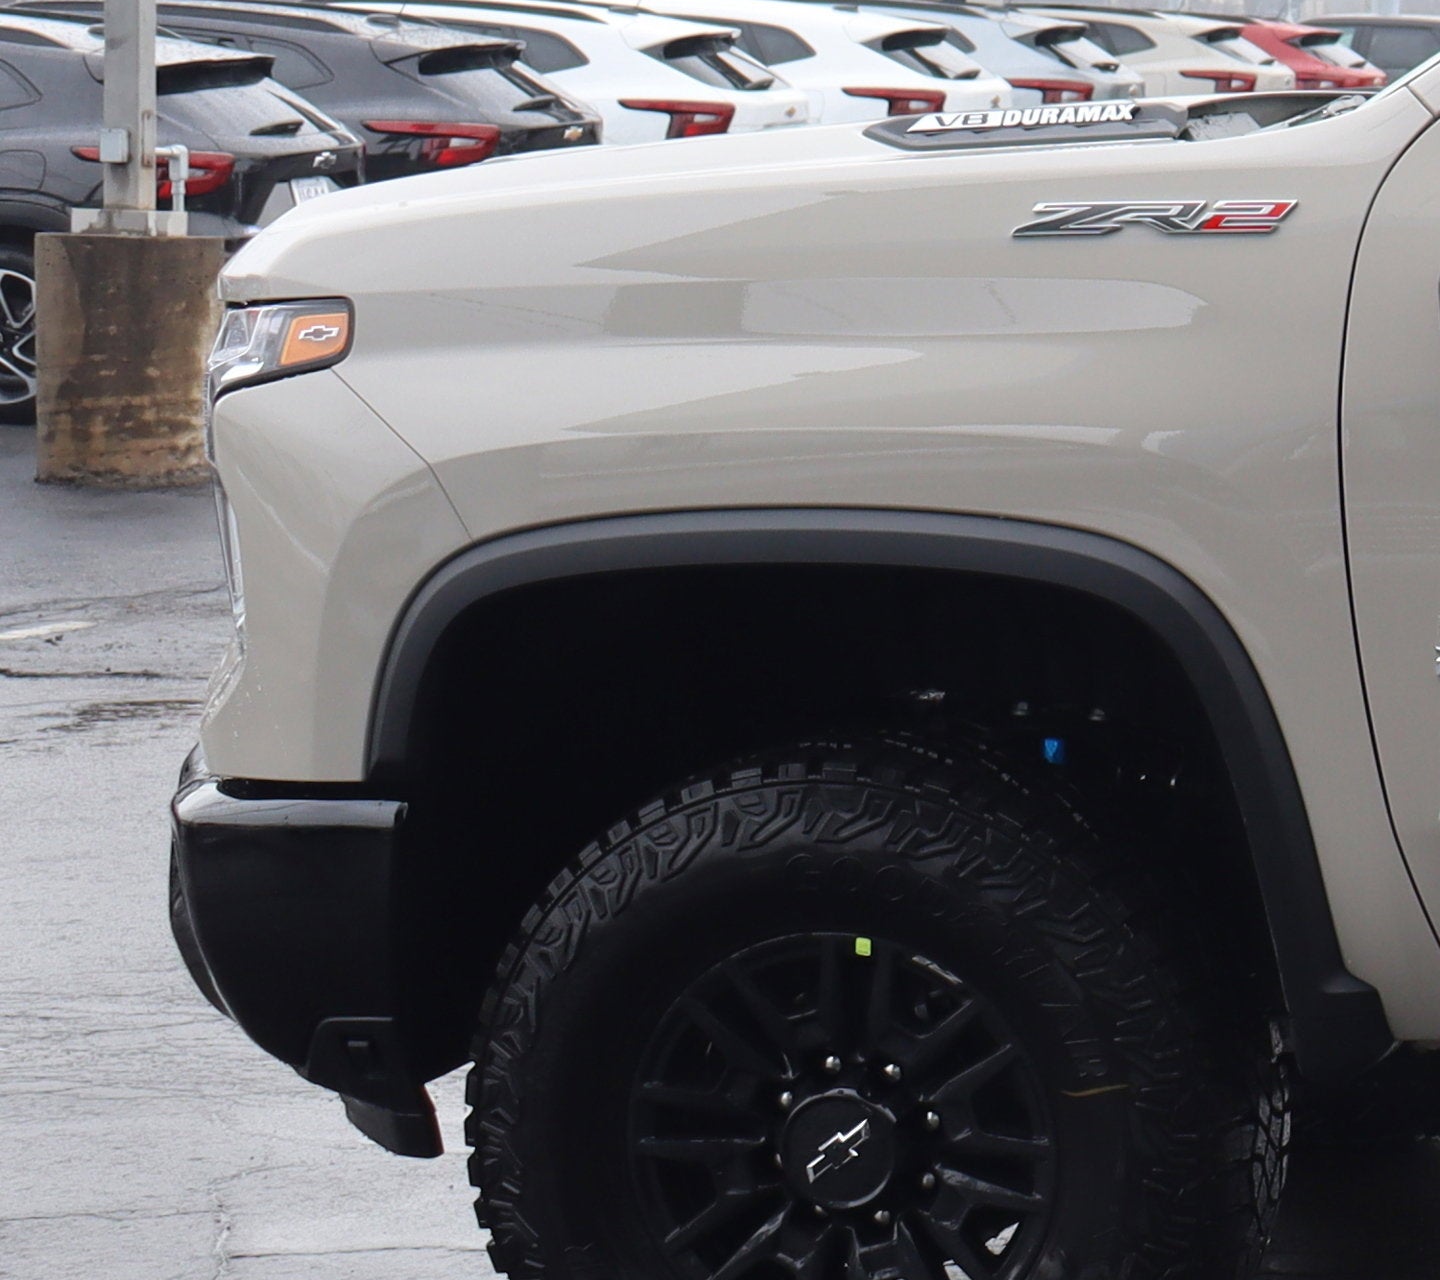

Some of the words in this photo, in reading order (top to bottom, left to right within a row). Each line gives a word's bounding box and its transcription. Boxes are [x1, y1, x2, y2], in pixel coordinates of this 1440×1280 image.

[933, 112, 990, 128] V8
[1001, 104, 1138, 127] DURAMAX
[1010, 198, 1300, 239] ZR2
